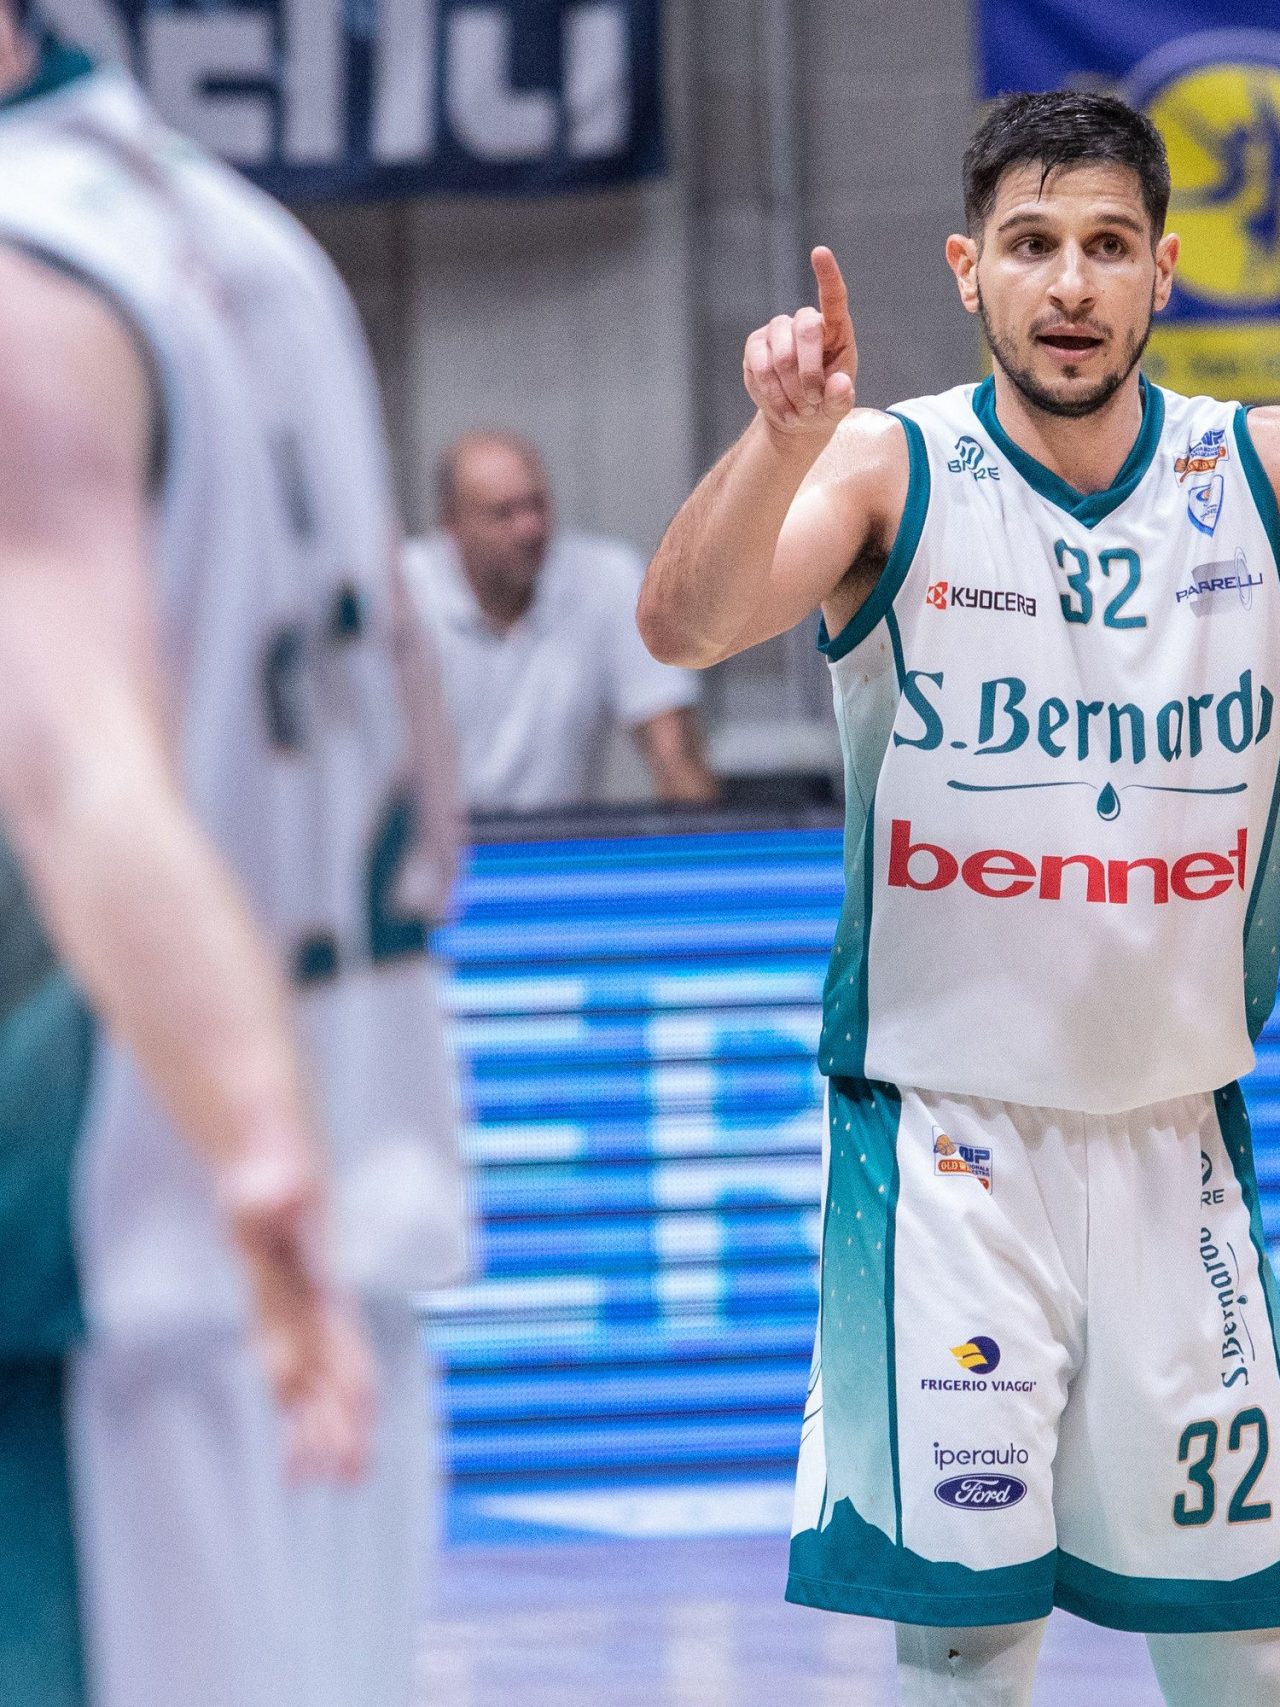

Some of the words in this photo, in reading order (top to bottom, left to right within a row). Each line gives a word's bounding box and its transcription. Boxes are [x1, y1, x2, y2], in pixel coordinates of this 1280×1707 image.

[1053, 538, 1147, 629] 32
[950, 586, 1037, 617] KYOCERA
[887, 819, 1248, 904] bennet
[921, 1379, 987, 1392] FRIGERIO
[991, 1381, 1034, 1392] VIAGGI
[933, 1442, 1029, 1471] iperauto
[1173, 1406, 1272, 1527] 32
[954, 1479, 1012, 1503] Ford
